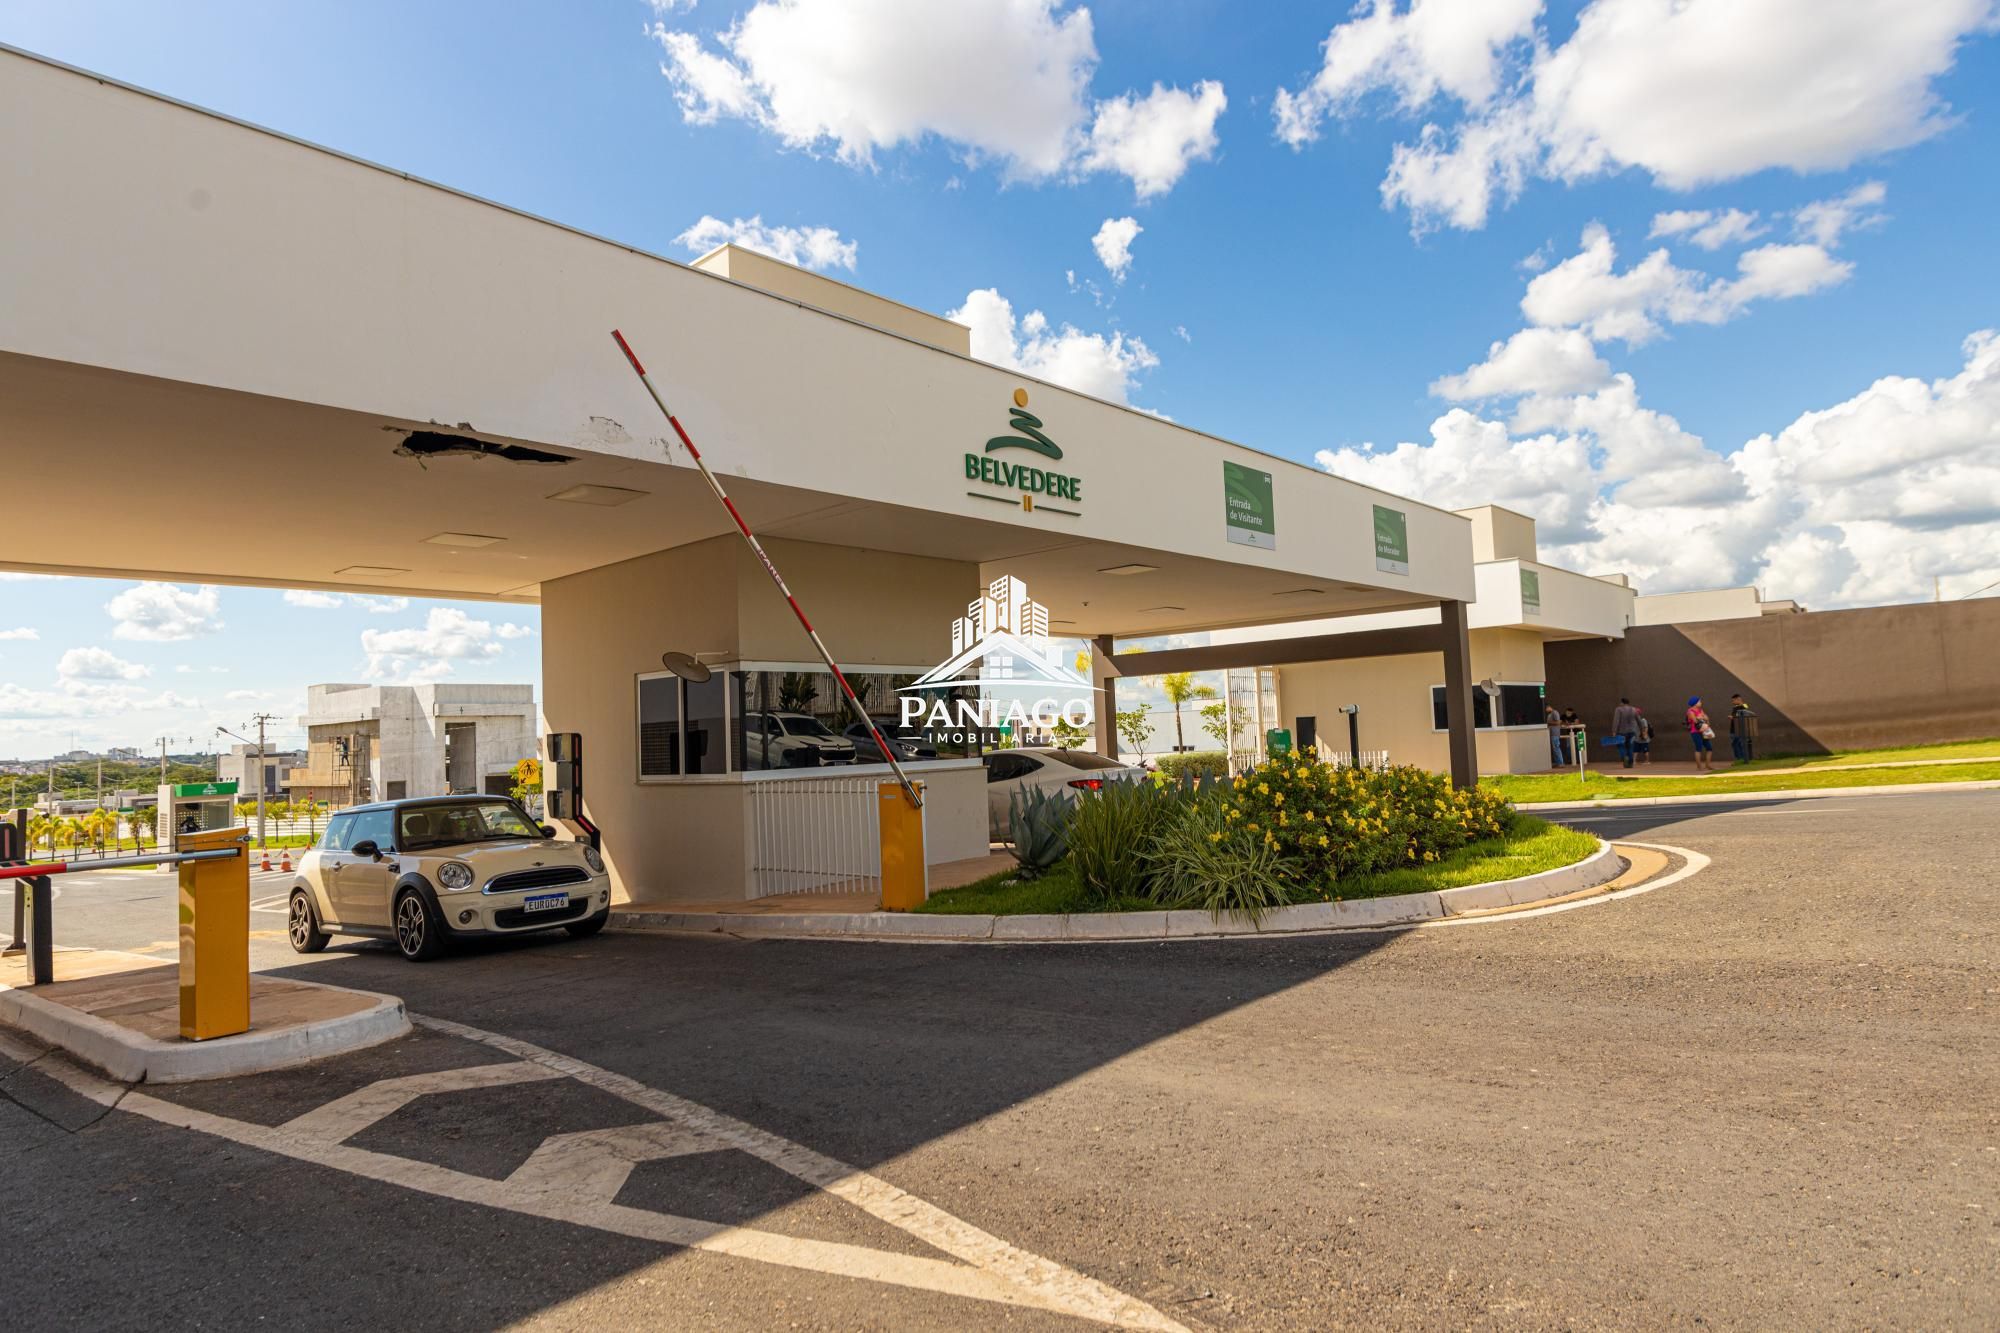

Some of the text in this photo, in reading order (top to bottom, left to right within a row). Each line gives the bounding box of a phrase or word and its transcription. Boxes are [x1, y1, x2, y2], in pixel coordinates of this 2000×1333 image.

[965, 453, 1082, 501] BELVEDERE
[1229, 497, 1251, 510] Entrada
[1230, 510, 1263, 526] de Visitante
